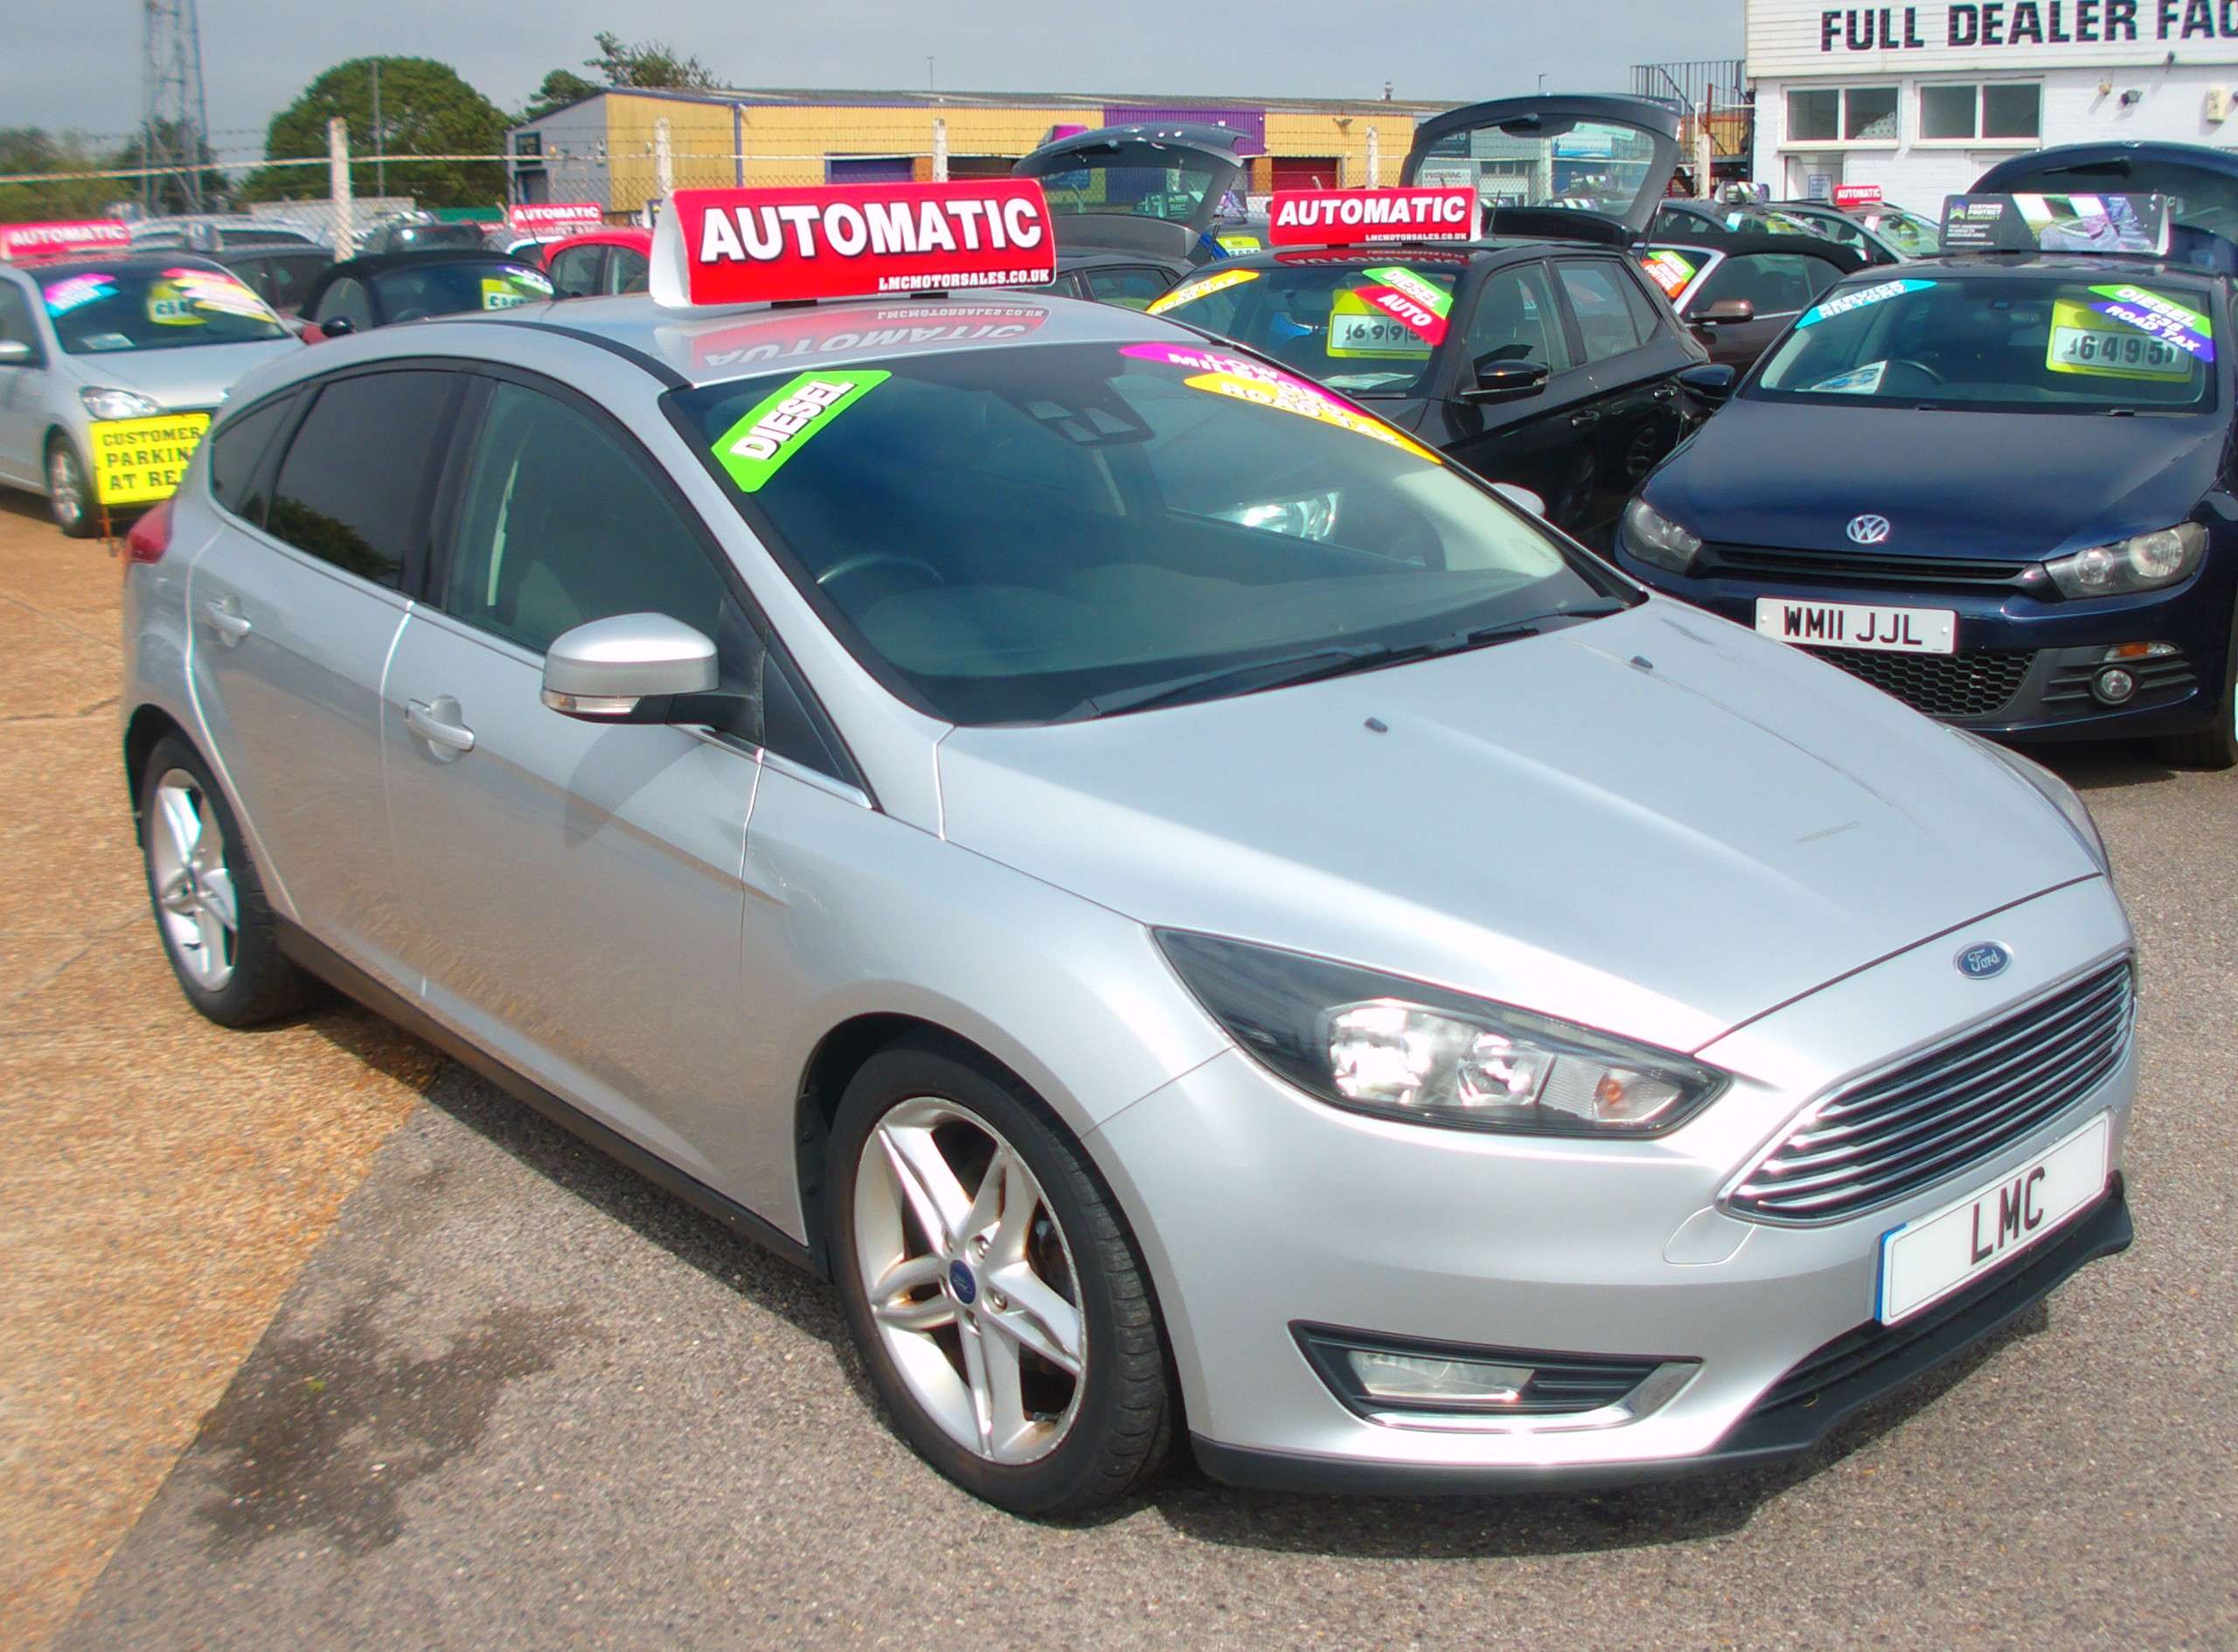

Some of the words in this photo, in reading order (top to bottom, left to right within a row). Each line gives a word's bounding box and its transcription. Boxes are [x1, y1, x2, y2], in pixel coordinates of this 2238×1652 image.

[1821, 7, 1925, 52] FULL
[1948, 0, 2137, 46] DEALER
[1837, 187, 1881, 199] AUTOMATIC
[513, 205, 600, 220] AUTOMATIC
[1276, 196, 1466, 226] AUTOMATIC
[10, 225, 127, 246] AUTOMATIC
[699, 198, 1043, 262] AUTOMATIC
[1365, 233, 1468, 242] LMCMOTORSALES.CO.UK
[878, 269, 1050, 291] LMCMOTORSALES.CO.UK
[1382, 270, 1442, 309] DIESEL
[1378, 294, 1434, 327] AUTO
[2114, 287, 2197, 328] DIESEL
[2105, 304, 2159, 331] ROAD
[2160, 330, 2201, 352] TAX
[1203, 353, 1278, 379] LOW
[1220, 381, 1322, 418] ROAD
[730, 378, 858, 461] DIESEL
[101, 427, 201, 447] CUSTOMER
[104, 447, 192, 468] PARKIN
[109, 473, 137, 490] AT
[147, 470, 178, 487] RE
[1783, 605, 1844, 641] WM11
[1855, 611, 1923, 645] JJL
[1970, 1165, 2046, 1267] LMC
